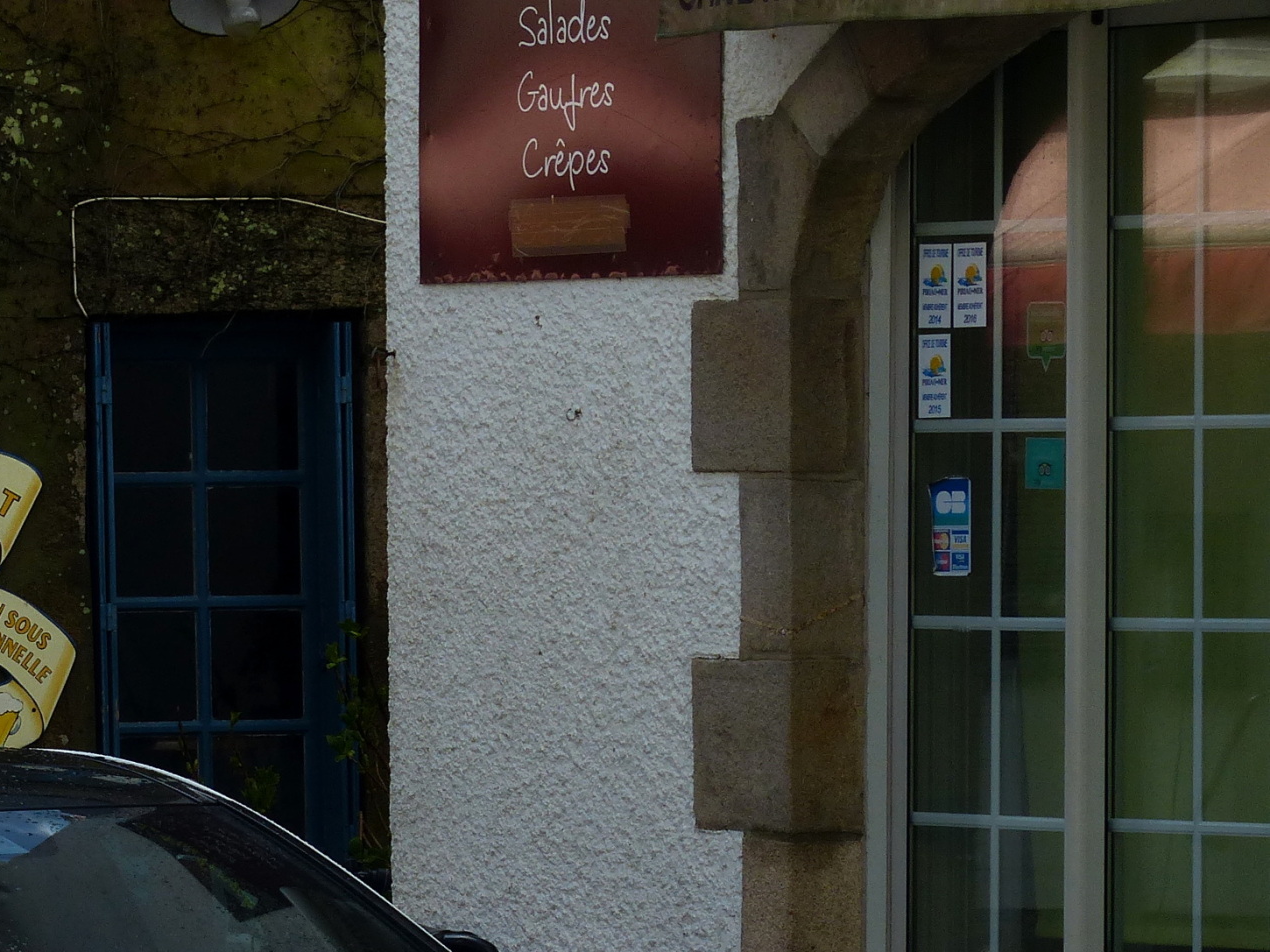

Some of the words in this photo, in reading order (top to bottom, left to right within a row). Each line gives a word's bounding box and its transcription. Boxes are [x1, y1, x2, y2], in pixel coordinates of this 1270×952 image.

[518, 0, 611, 48] Salades
[517, 71, 614, 131] Gaufres
[521, 138, 611, 191] Crêpes
[4, 609, 52, 650] SOUS
